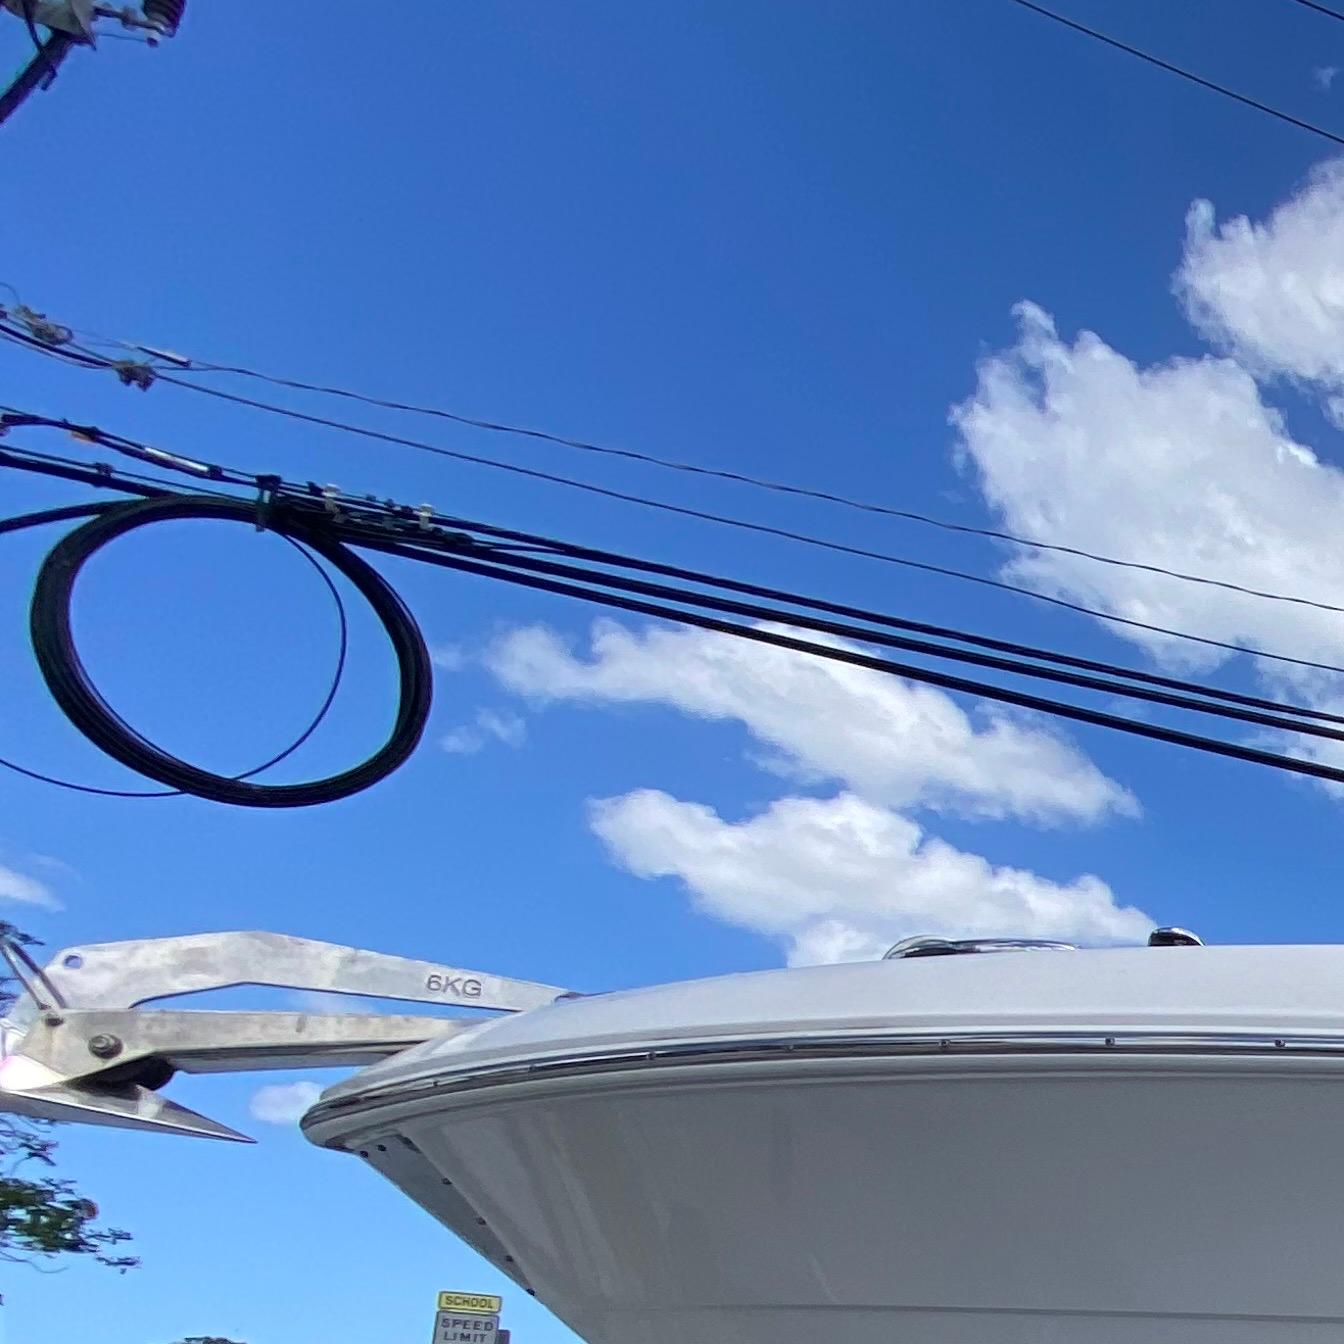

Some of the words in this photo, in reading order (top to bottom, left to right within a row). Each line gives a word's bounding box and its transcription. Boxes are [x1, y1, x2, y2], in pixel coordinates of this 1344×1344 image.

[427, 974, 482, 997] 6KG
[445, 1295, 494, 1309] SCHOOL
[441, 1318, 494, 1332] SPEED
[444, 1331, 488, 1343] LIMIT
